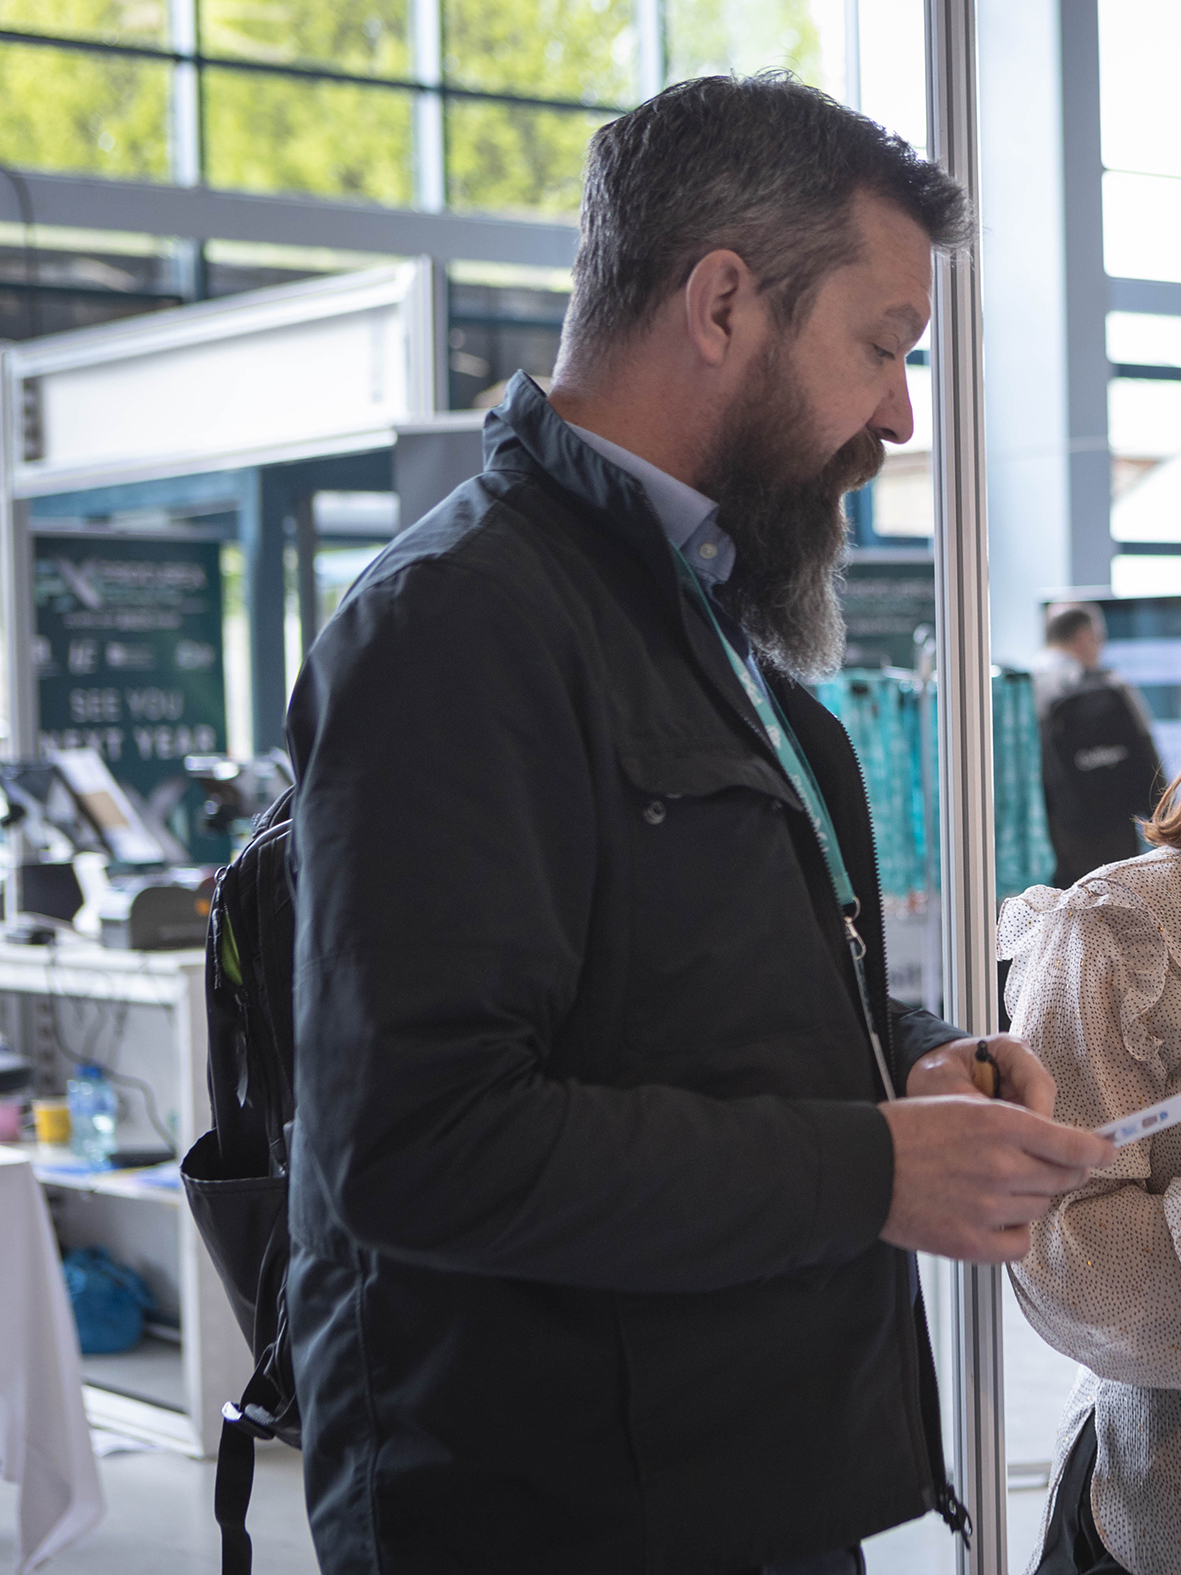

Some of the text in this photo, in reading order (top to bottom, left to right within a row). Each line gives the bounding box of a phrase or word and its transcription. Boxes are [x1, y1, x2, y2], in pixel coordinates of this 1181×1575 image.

[69, 686, 184, 723] SEE YOU
[132, 725, 217, 760] YEAR
